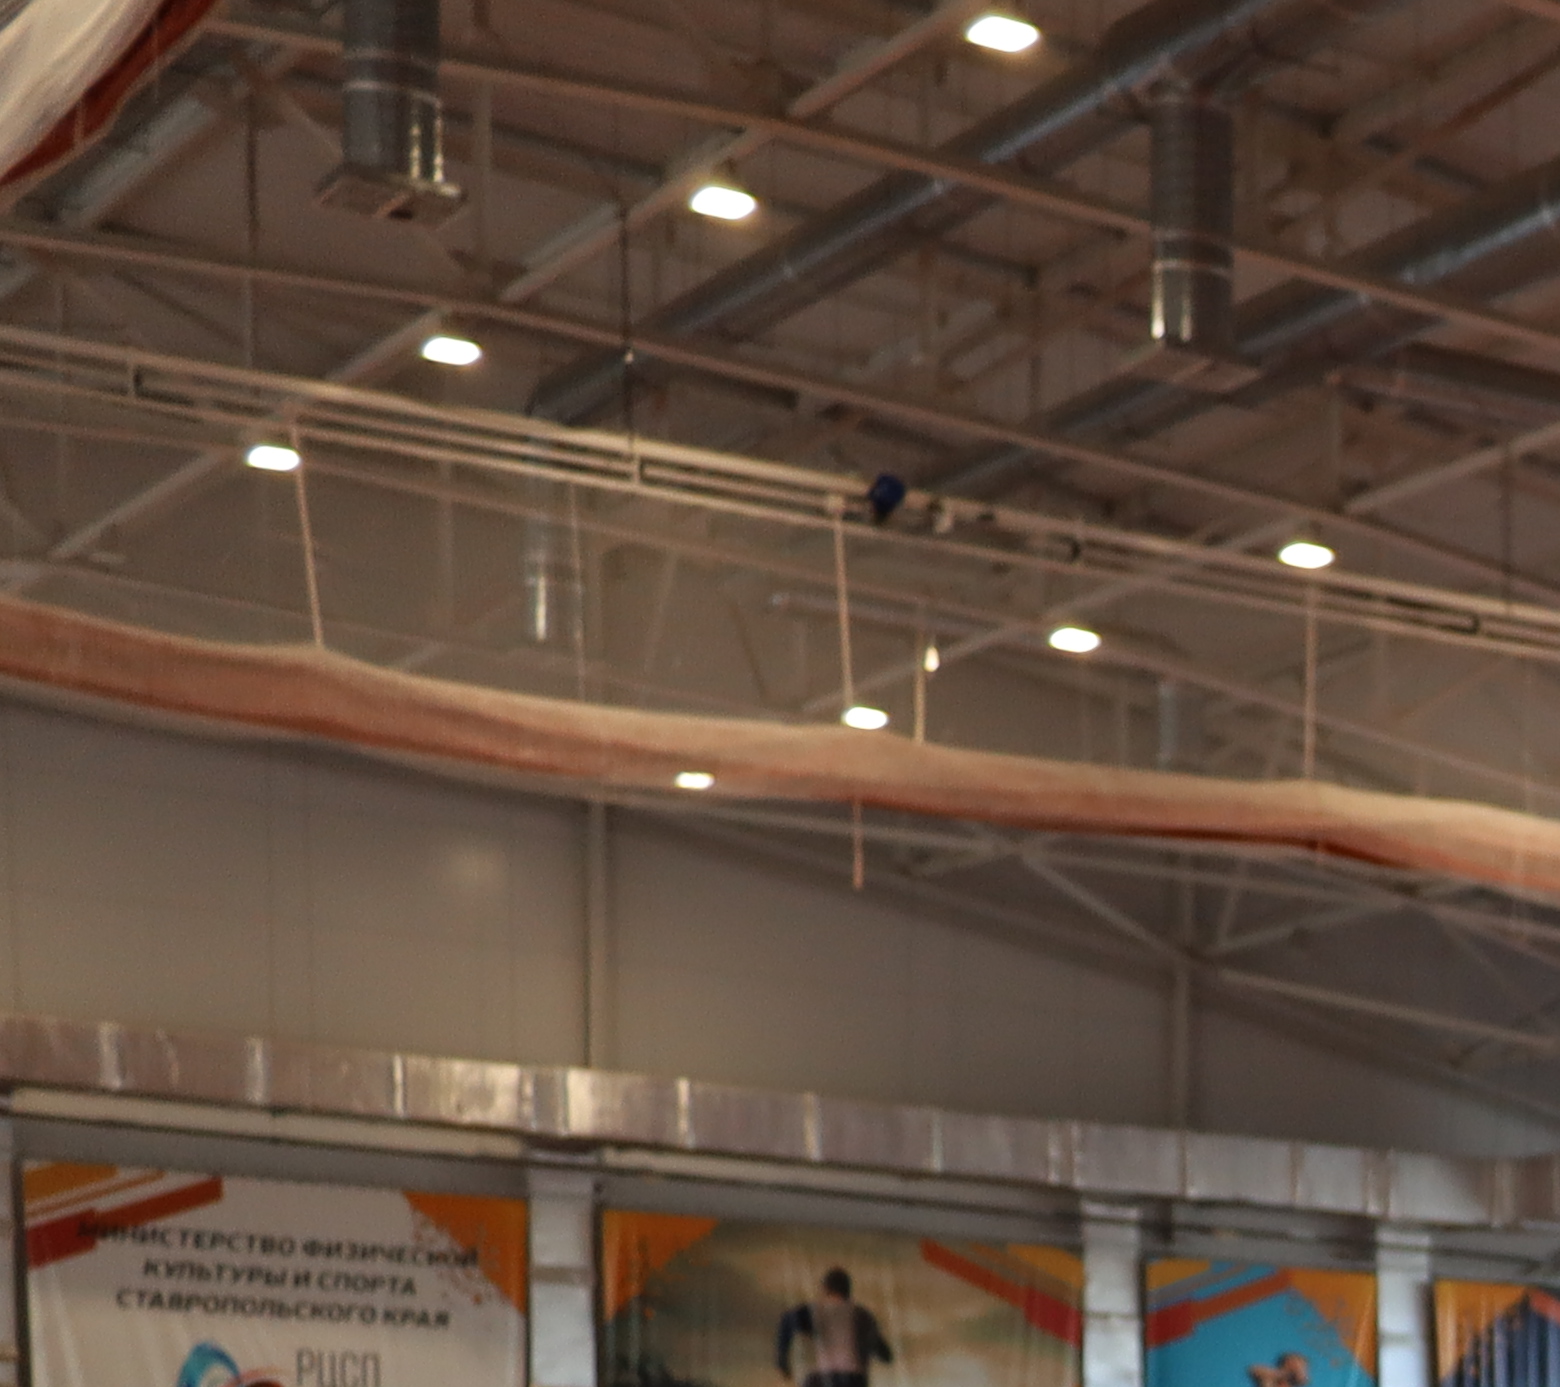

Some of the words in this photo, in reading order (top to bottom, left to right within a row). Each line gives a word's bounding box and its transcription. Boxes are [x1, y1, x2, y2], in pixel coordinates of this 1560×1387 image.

[79, 1222, 296, 1257] МИНИСТЕРСТВО
[302, 1237, 480, 1269] ФИЗИЧЕСКОЙ
[143, 1257, 288, 1288] КУЛЬТУРЫ
[293, 1270, 311, 1289] И
[317, 1270, 418, 1296] СПОРТА
[116, 1287, 377, 1326] СТАВРОПОЛЬСКОГО
[382, 1309, 450, 1330] КРАЯ
